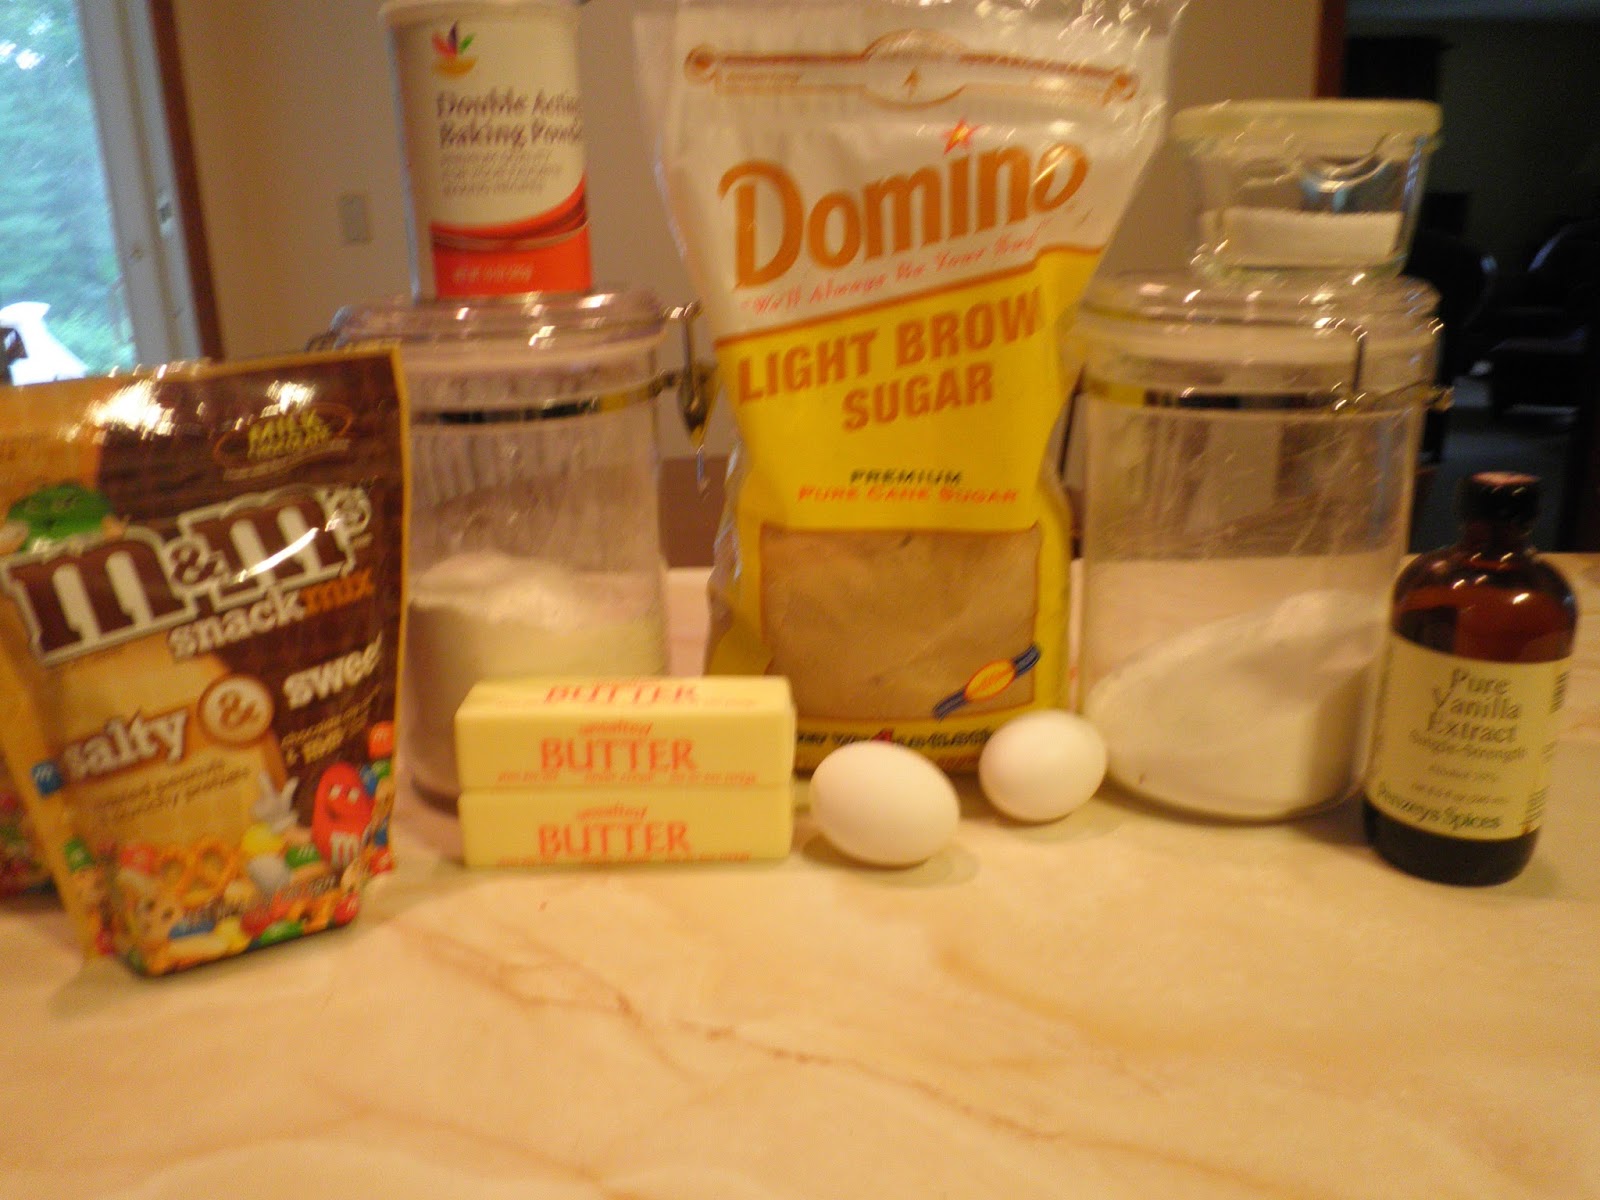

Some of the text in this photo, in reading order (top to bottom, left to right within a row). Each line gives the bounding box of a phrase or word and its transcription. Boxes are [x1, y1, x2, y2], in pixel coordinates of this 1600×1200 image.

[440, 118, 527, 149] Baking
[717, 138, 1089, 290] Domino
[736, 285, 1043, 404] LIGHT BROW
[841, 360, 995, 432] SUGAR
[850, 468, 963, 485] PREMIUM
[798, 484, 1019, 504] PURE CANE SUGAR
[1450, 667, 1512, 696] Pure
[1431, 686, 1522, 719] Vanilla
[1427, 710, 1520, 744] Extract
[61, 708, 191, 781] salty
[539, 737, 698, 773] BUTTER
[1443, 805, 1503, 832] Spices
[537, 822, 691, 859] BUTTER
